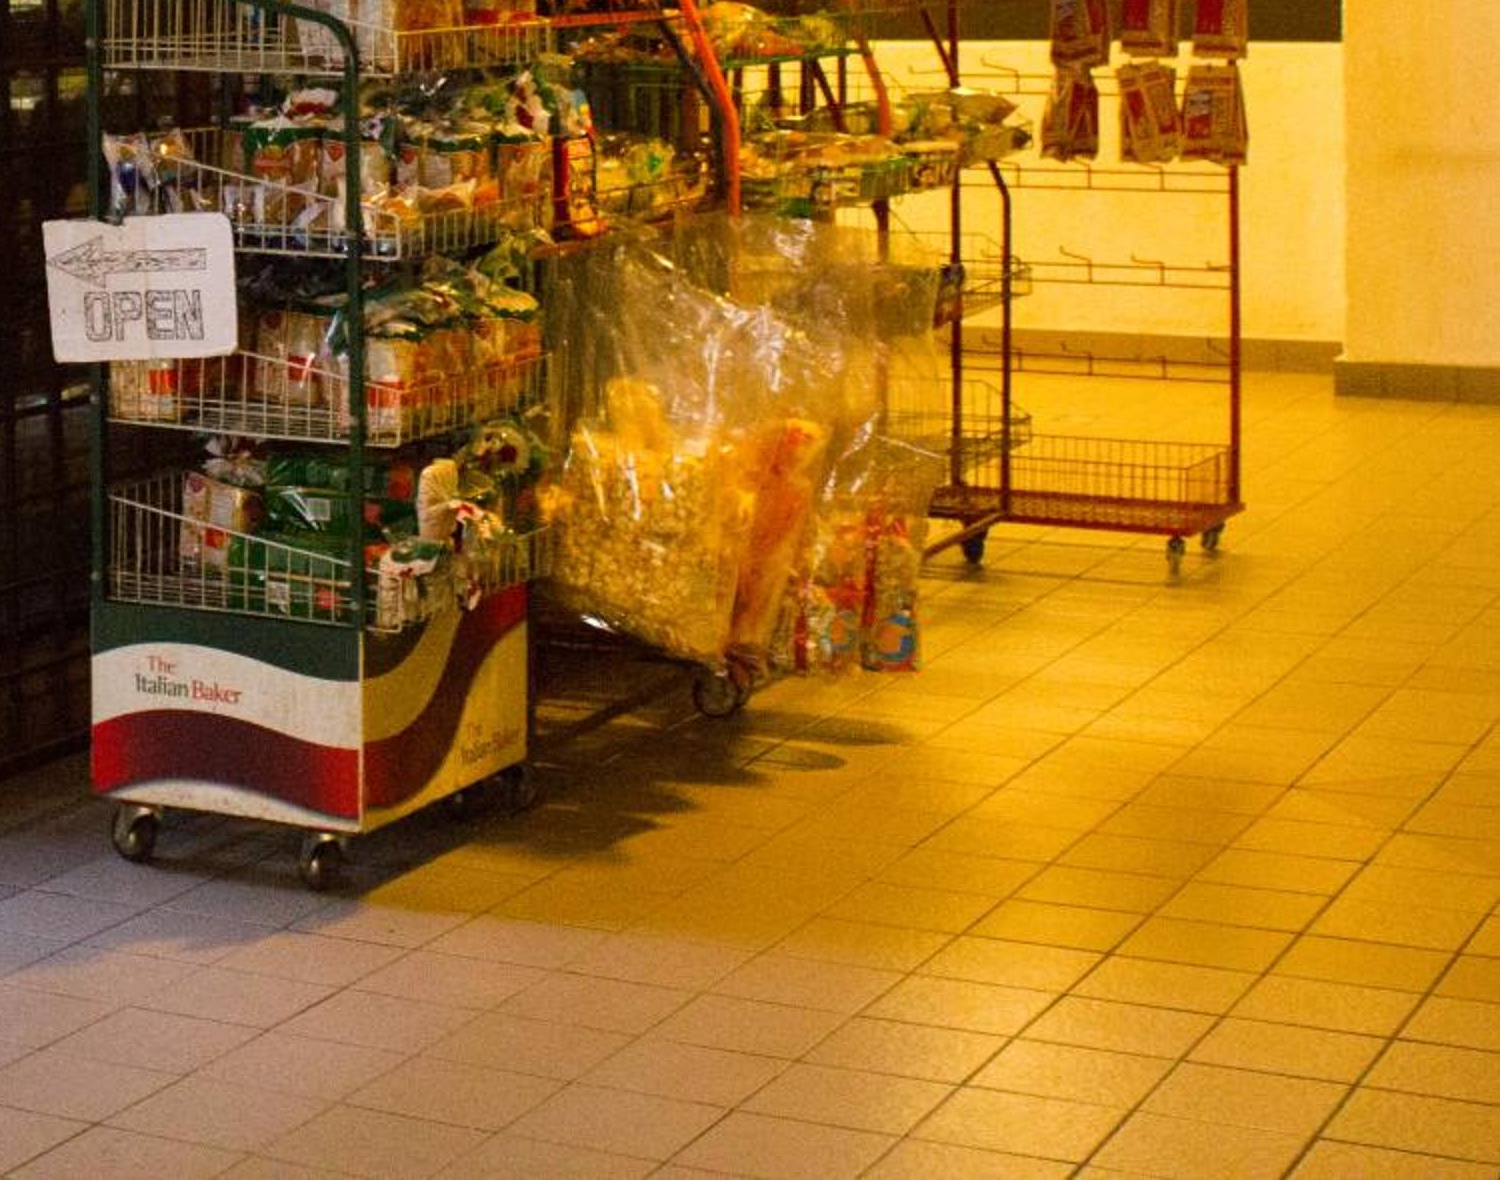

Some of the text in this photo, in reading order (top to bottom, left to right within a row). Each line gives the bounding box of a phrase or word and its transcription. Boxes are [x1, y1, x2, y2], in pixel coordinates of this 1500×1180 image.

[83, 288, 205, 343] OPEN
[146, 655, 177, 674] The
[135, 672, 243, 704] Italian Baker
